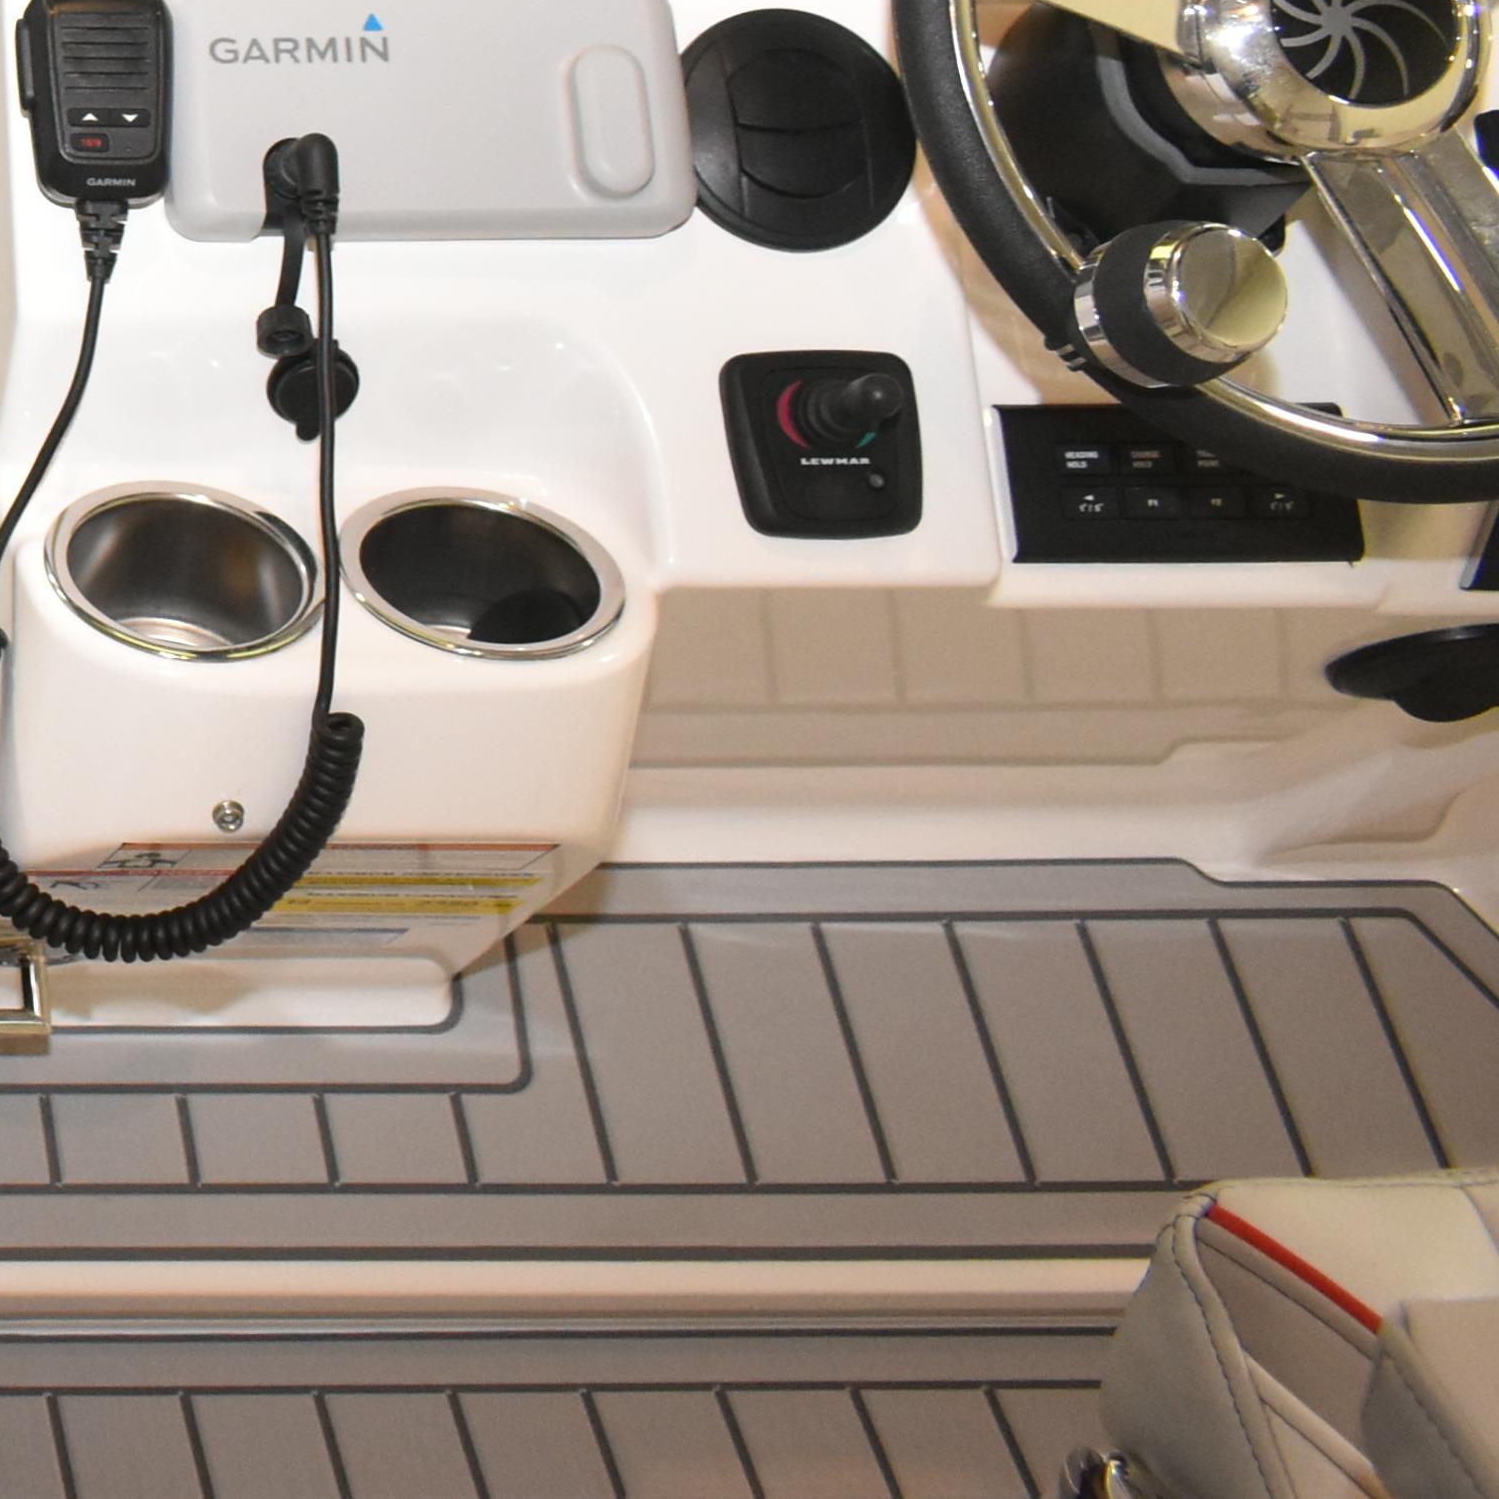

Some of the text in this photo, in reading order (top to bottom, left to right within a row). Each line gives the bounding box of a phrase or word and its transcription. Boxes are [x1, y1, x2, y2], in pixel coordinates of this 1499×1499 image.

[209, 37, 390, 64] GARMIN
[86, 177, 136, 187] GARMIN
[800, 457, 870, 465] LEWMAR
